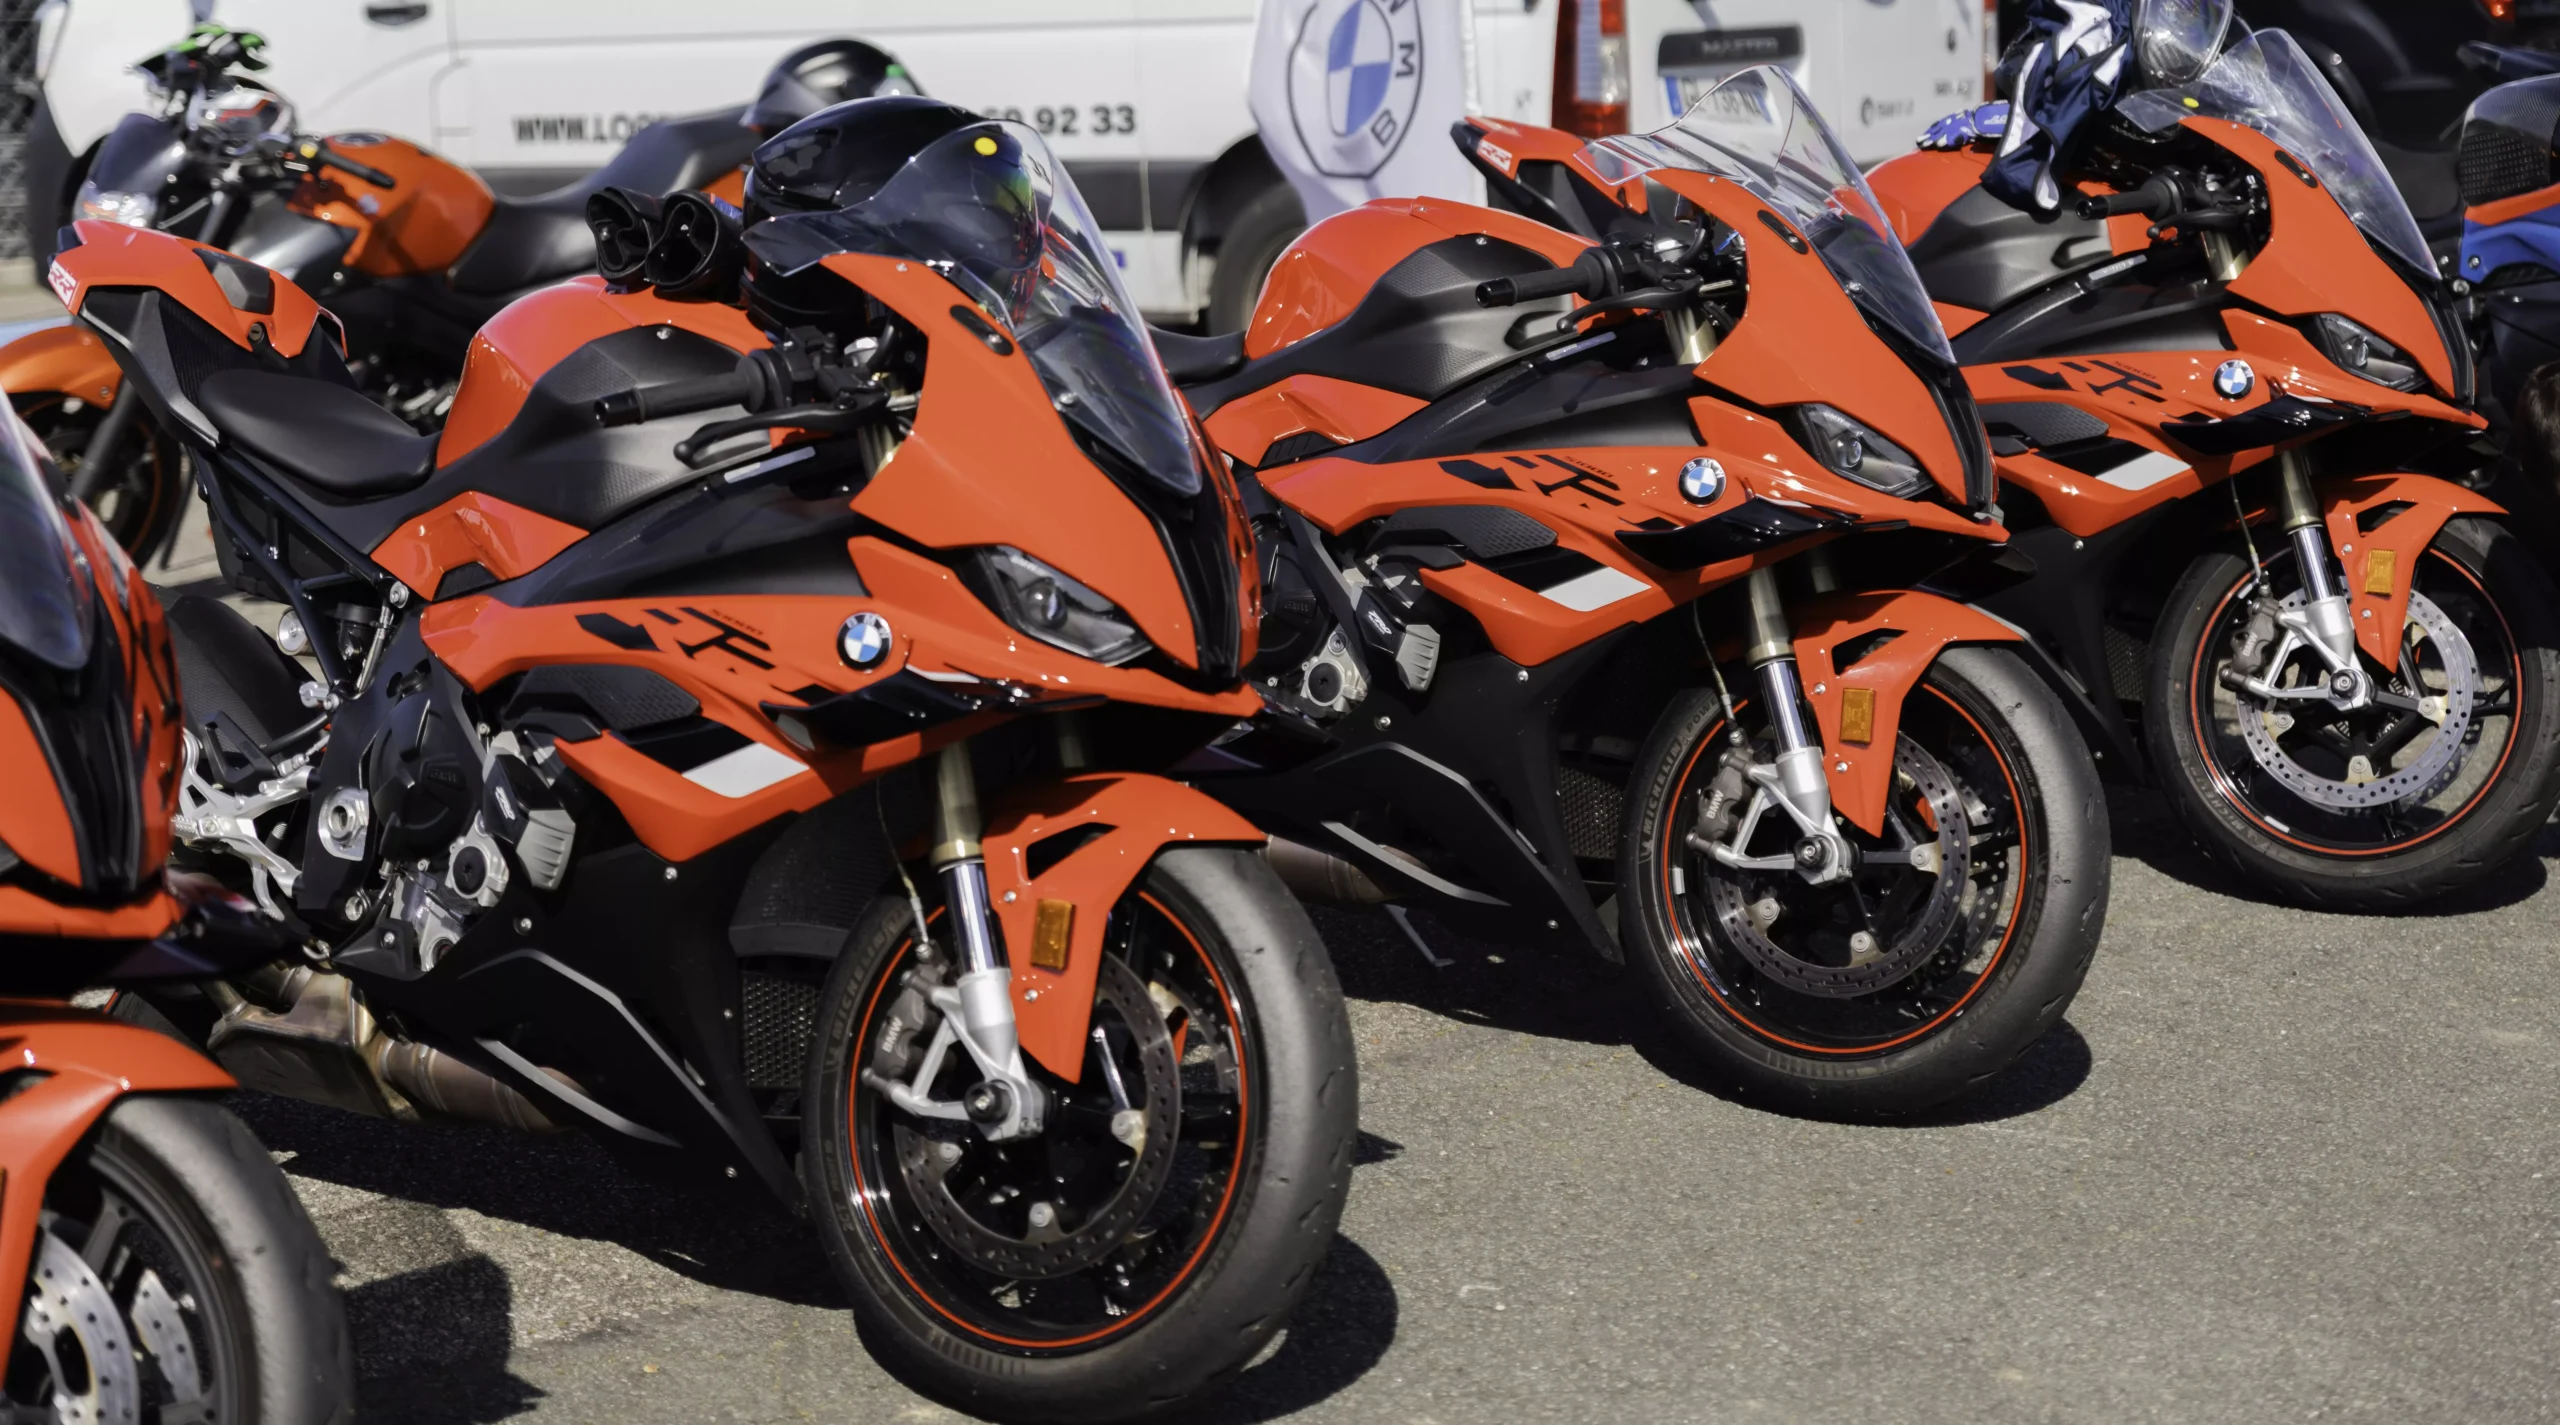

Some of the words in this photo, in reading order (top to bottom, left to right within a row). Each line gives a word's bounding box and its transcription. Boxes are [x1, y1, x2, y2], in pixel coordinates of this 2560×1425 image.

[511, 113, 662, 144] WWW.LO
[1036, 107, 1078, 135] 92
[1092, 105, 1135, 134] 33
[50, 267, 77, 296] RR
[2001, 726, 2019, 748] 2CT
[1643, 741, 1683, 836] MICHELIN
[1686, 698, 1720, 734] POWE
[1706, 789, 1725, 820] BMW
[831, 930, 886, 1041] MICHELIN
[881, 1016, 905, 1053] BMW
